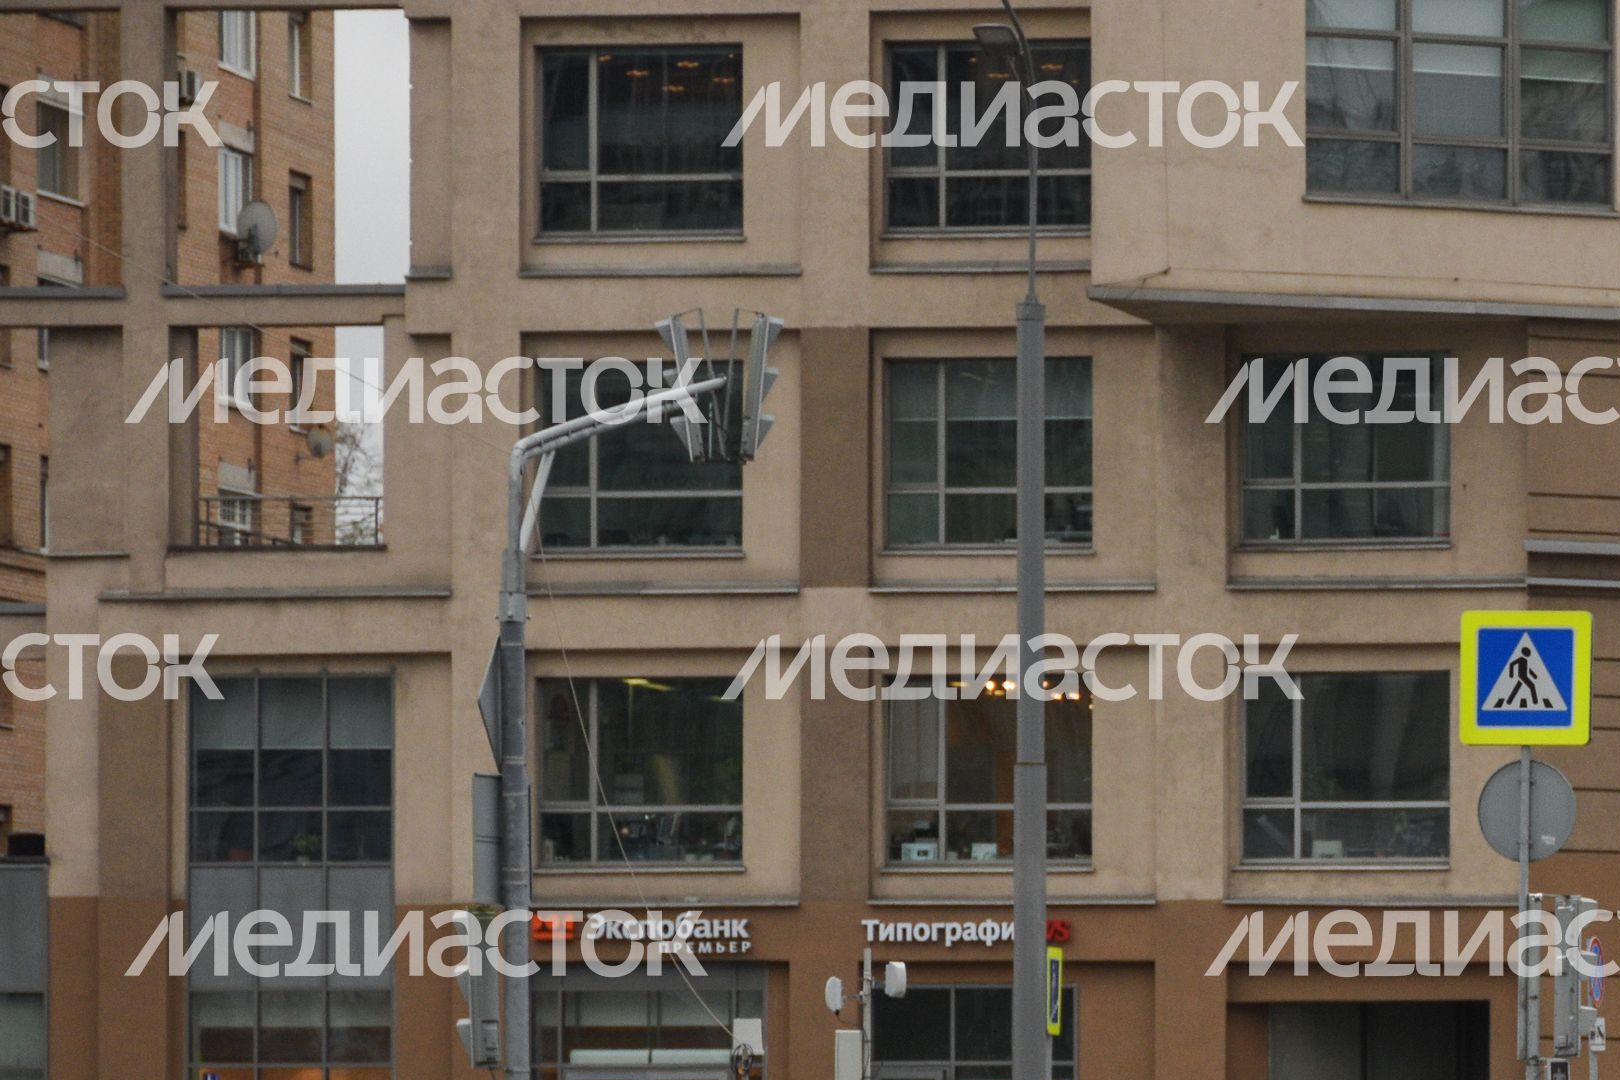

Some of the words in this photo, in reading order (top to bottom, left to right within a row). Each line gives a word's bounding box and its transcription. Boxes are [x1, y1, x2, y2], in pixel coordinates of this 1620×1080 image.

[586, 911, 750, 940] Экспобанк
[860, 917, 1015, 947] Типографи
[657, 941, 752, 955] ПРЕМЬЕР
